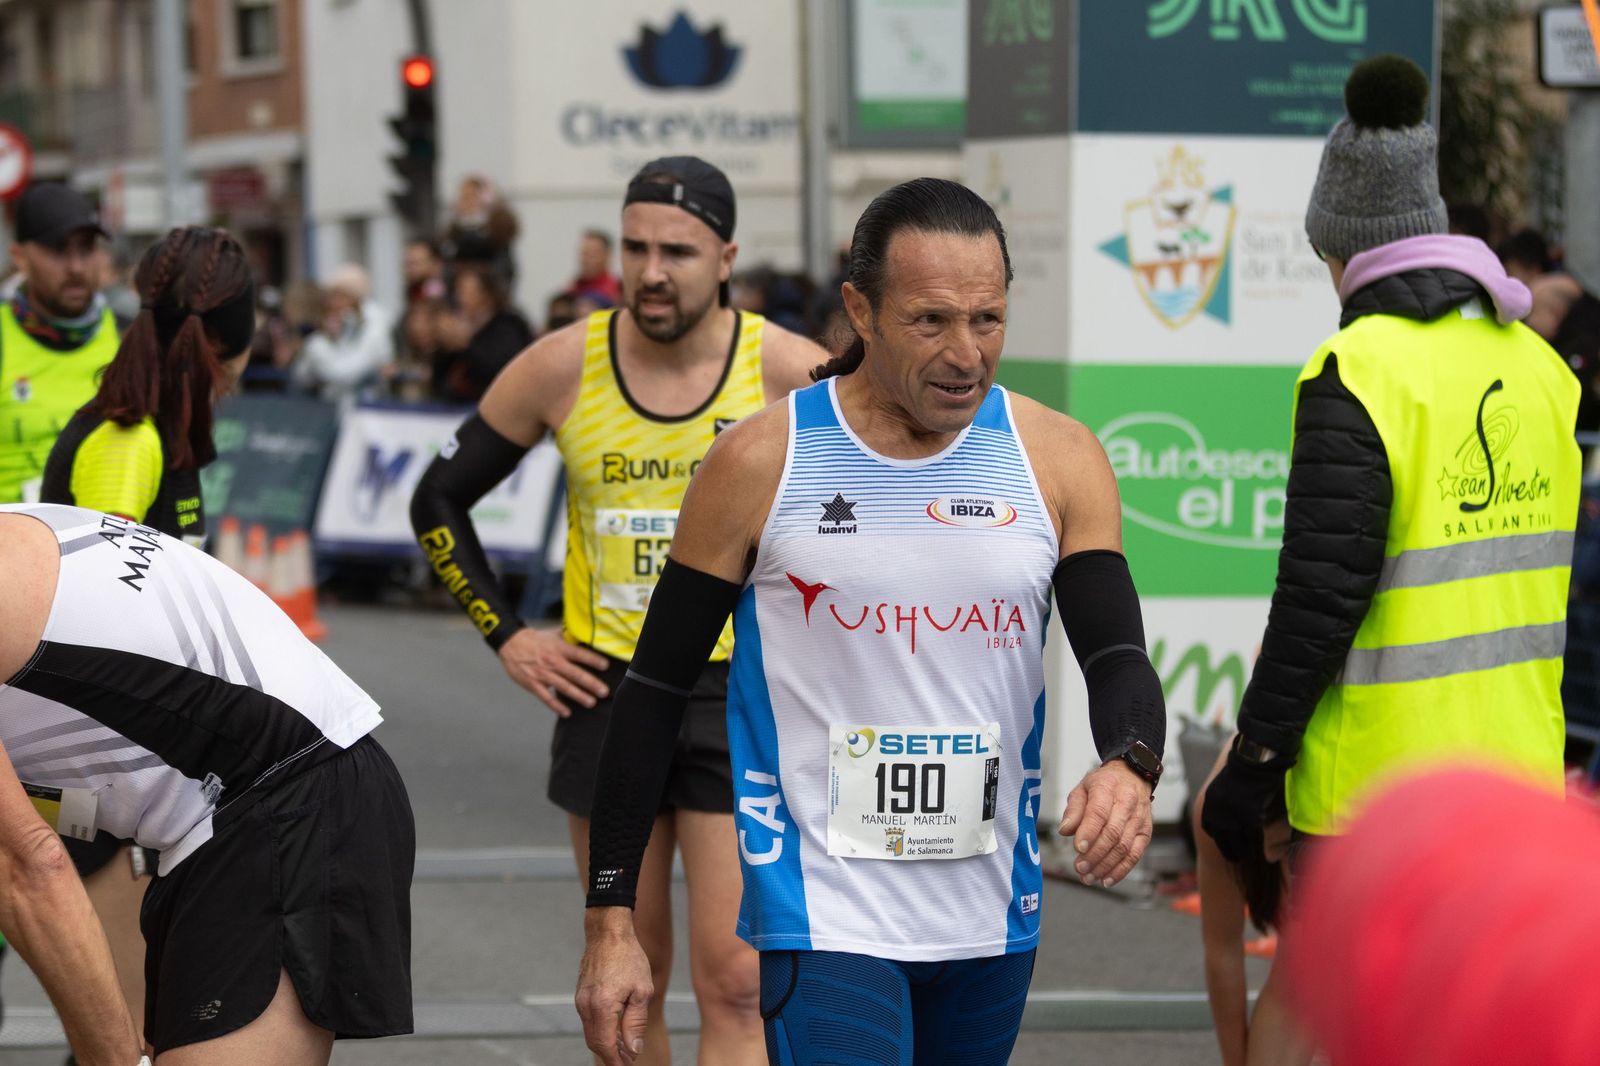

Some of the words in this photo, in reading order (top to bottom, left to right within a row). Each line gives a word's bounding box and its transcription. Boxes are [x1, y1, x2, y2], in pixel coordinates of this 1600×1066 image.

[1178, 479, 1234, 528] el
[950, 505, 996, 518] IBIZA
[818, 525, 858, 534] luanvi
[829, 598, 1026, 655] USHUAÏA
[987, 637, 1022, 649] IBIZA
[879, 734, 989, 755] SETEL
[874, 762, 946, 814] 190
[739, 768, 786, 866] CAI
[861, 814, 906, 826] MANUEL
[913, 813, 957, 826] MARTÍN
[907, 836, 954, 846] Ayuntamiento
[907, 847, 916, 855] de
[917, 846, 954, 855] Salamanca
